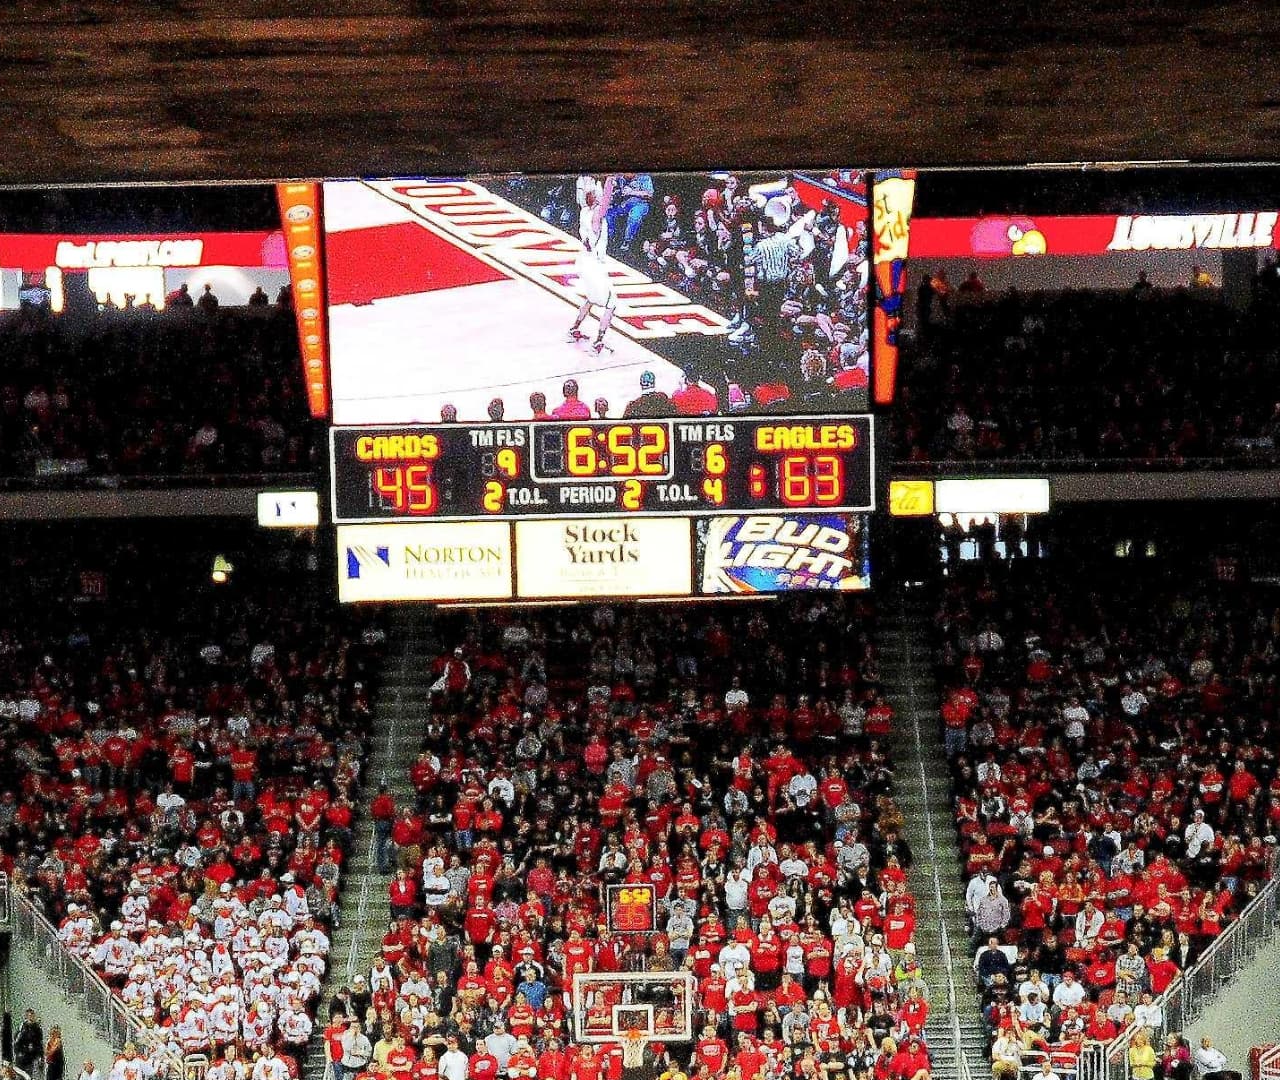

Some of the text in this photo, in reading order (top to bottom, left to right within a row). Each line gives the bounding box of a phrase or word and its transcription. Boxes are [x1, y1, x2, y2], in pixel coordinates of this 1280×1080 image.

[469, 428, 526, 446] TM FLS
[678, 423, 736, 442] TM FLS
[755, 425, 856, 451] EAGLES
[356, 434, 440, 460] CARDS
[567, 425, 667, 476] 6:52
[705, 443, 727, 475] 6
[495, 448, 519, 479] 9
[376, 465, 435, 511] 45
[656, 483, 699, 502] T.O.L.
[703, 477, 724, 505] 4
[783, 455, 842, 503] 63
[482, 481, 504, 513] 2
[507, 487, 549, 505] T.O.L.
[559, 485, 617, 504] PERIOD
[622, 478, 644, 510] 2
[565, 523, 639, 543] Stock
[734, 516, 851, 553] BUD
[404, 544, 503, 564] NORTON
[566, 544, 639, 563] Yards
[720, 541, 854, 578] LIGHT
